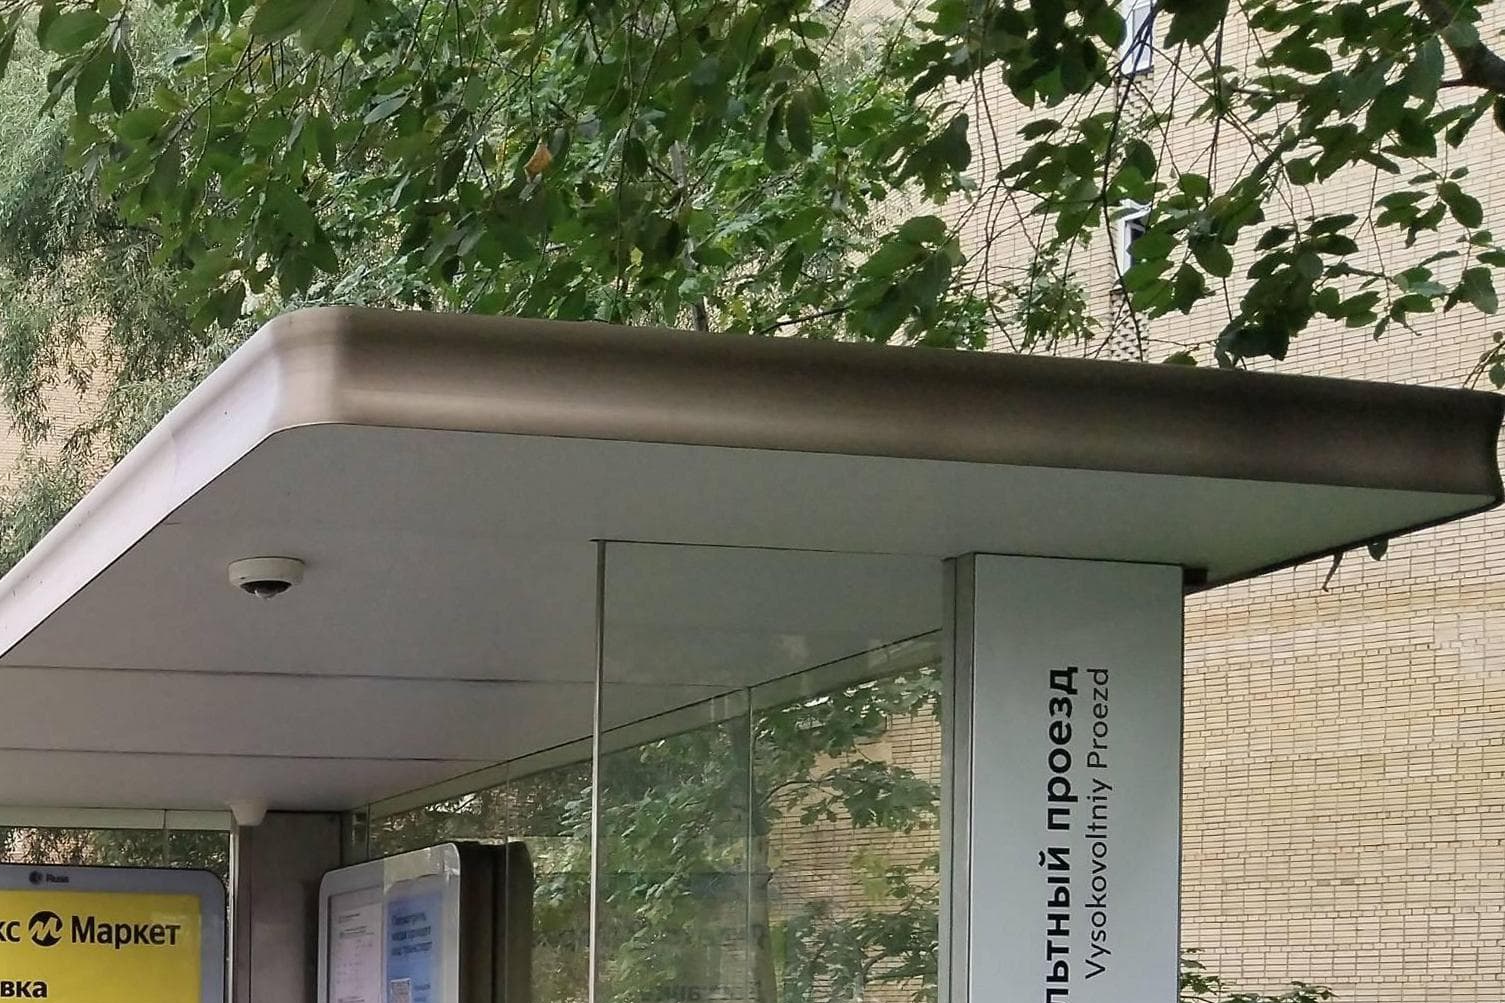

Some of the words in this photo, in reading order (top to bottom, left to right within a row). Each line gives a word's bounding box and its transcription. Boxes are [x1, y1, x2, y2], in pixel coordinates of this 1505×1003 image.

[1047, 666, 1078, 830] проезд
[1086, 667, 1110, 769] Proezd
[71, 915, 181, 949] Маркет
[1085, 780, 1112, 979] Vysokovoltniy
